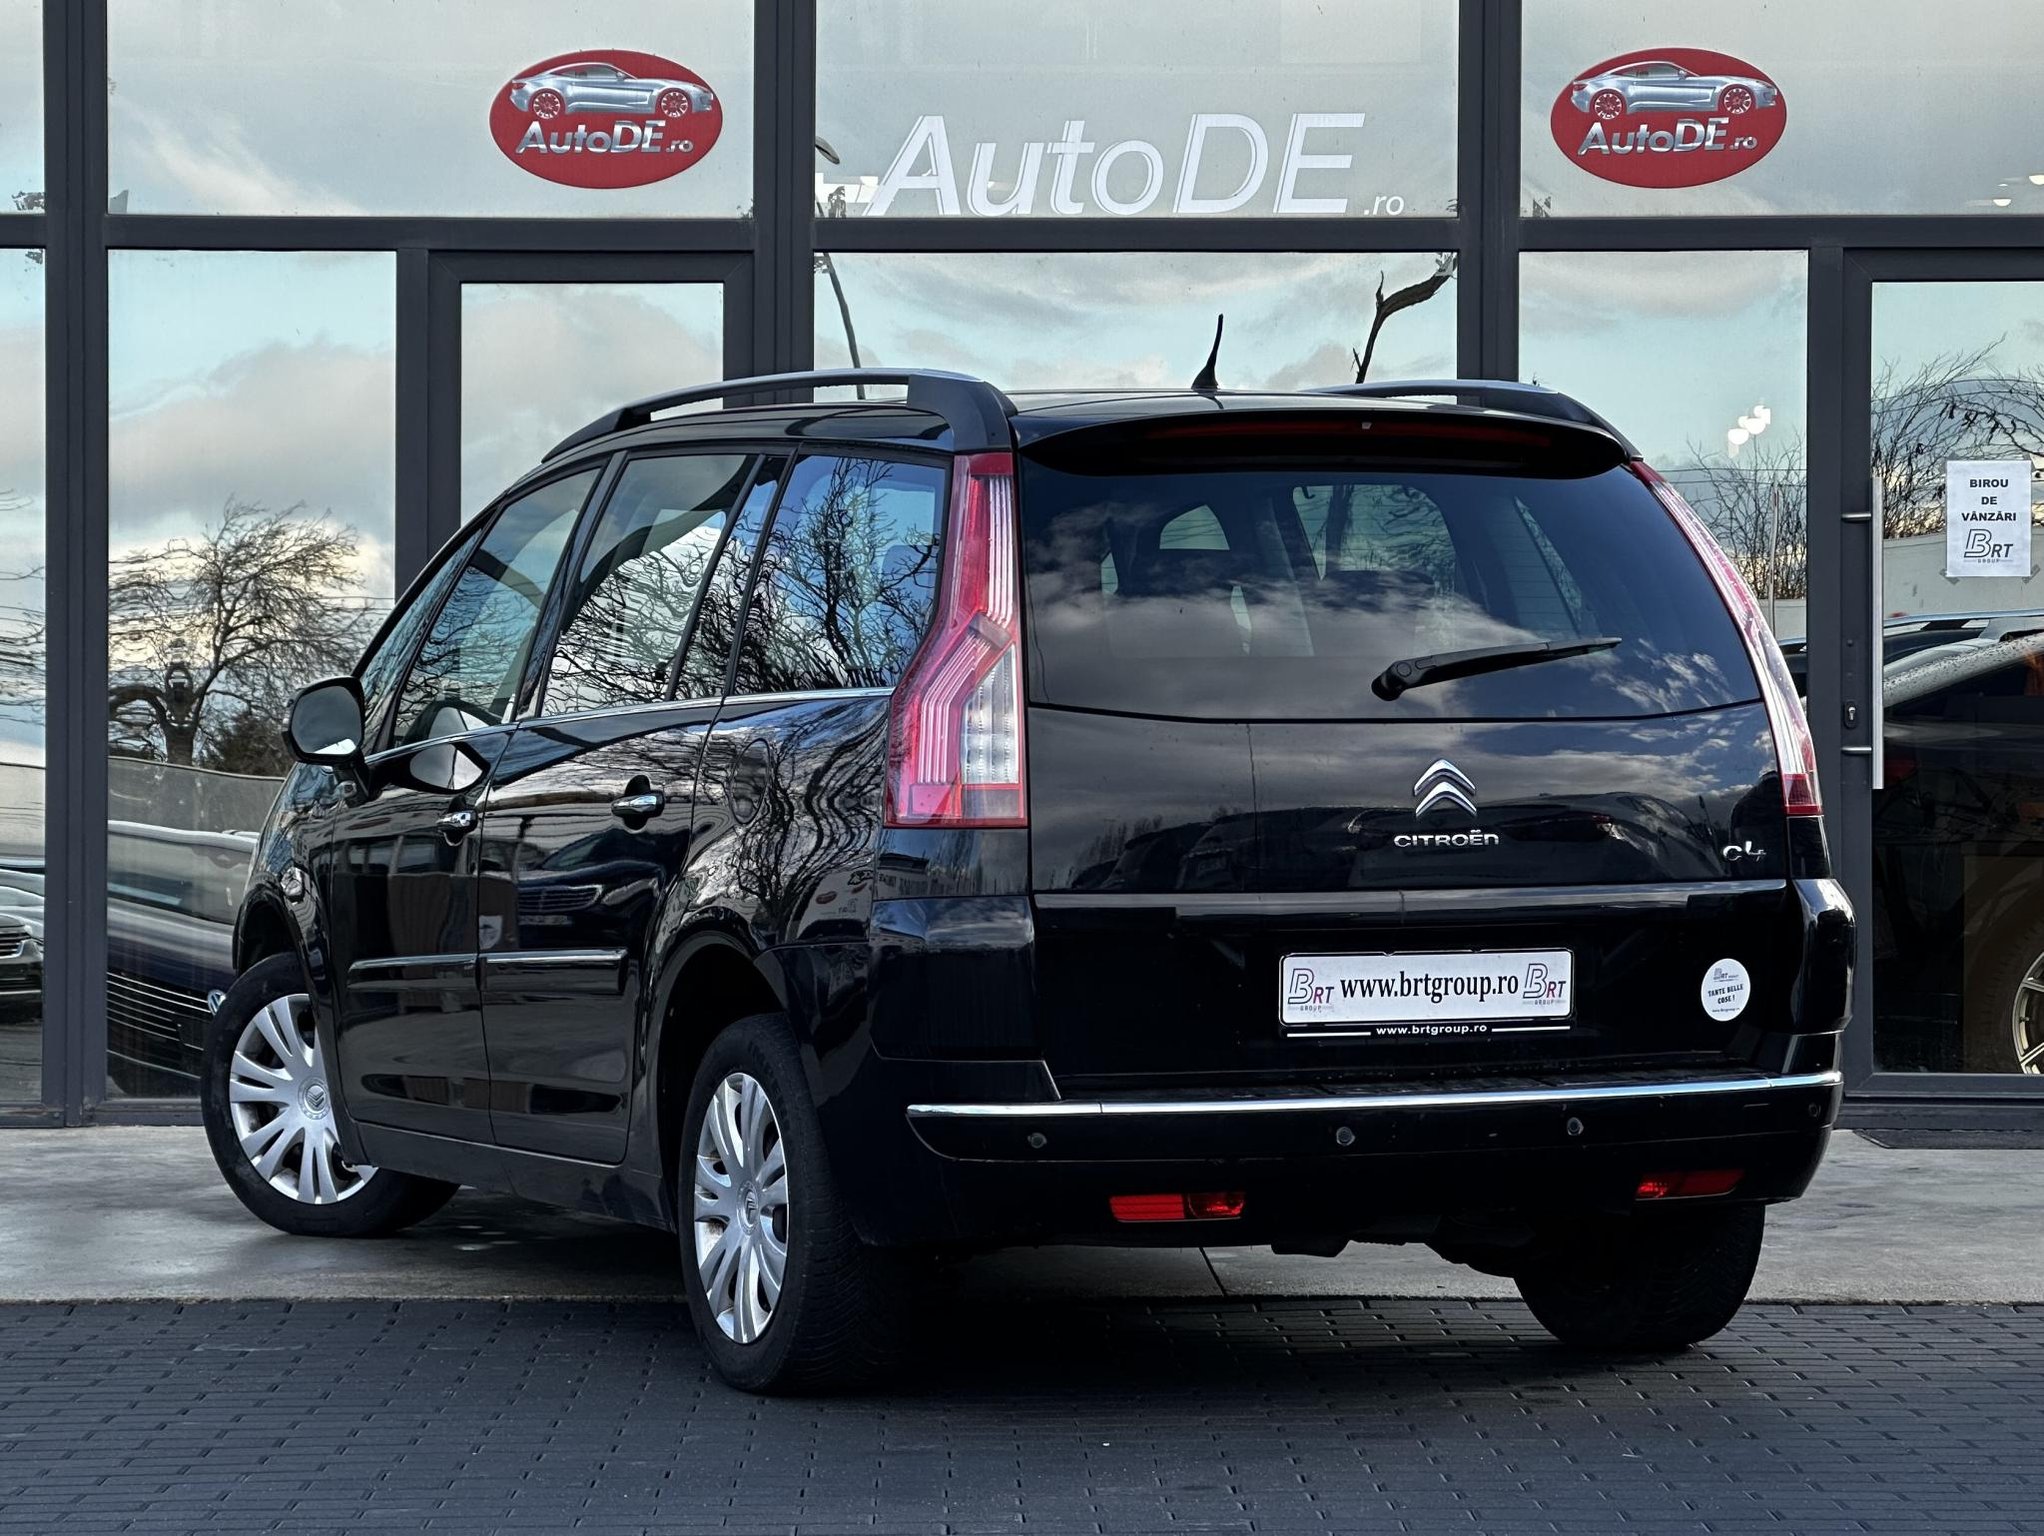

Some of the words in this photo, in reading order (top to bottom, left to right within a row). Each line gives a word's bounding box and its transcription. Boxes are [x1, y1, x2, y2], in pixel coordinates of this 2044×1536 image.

[1969, 478, 2009, 488] BIROU
[1981, 496, 1998, 505] DE
[1963, 528, 2014, 558] BRT
[1722, 840, 1767, 862] C4
[1340, 971, 1519, 1003] www.brtgroup.ro
[1376, 1024, 1488, 1036] www.brtgroup.ro
